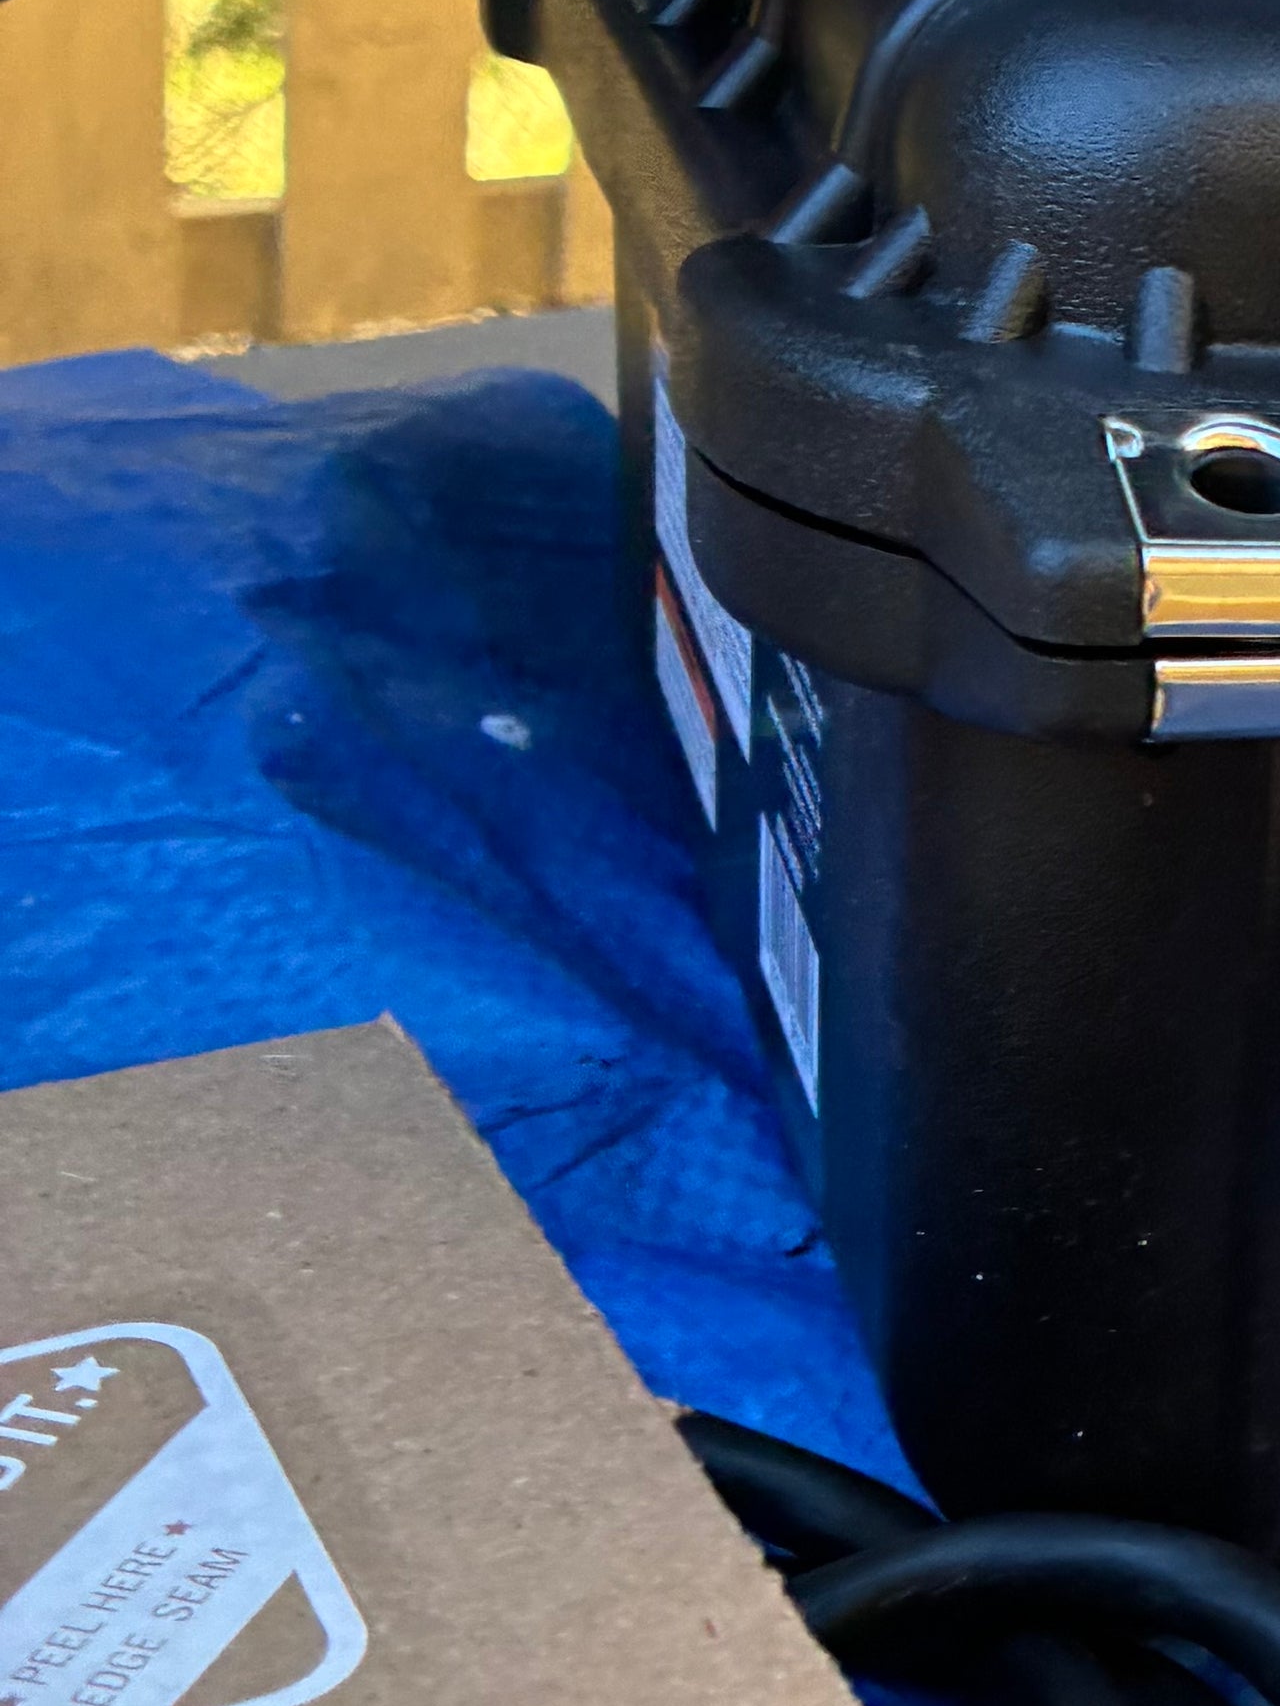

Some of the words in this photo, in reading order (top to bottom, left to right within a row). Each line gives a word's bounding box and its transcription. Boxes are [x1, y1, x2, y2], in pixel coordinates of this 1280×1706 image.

[9, 1623, 106, 1687] PEEL
[79, 1541, 178, 1612] HERE
[151, 1547, 250, 1622] SEAM
